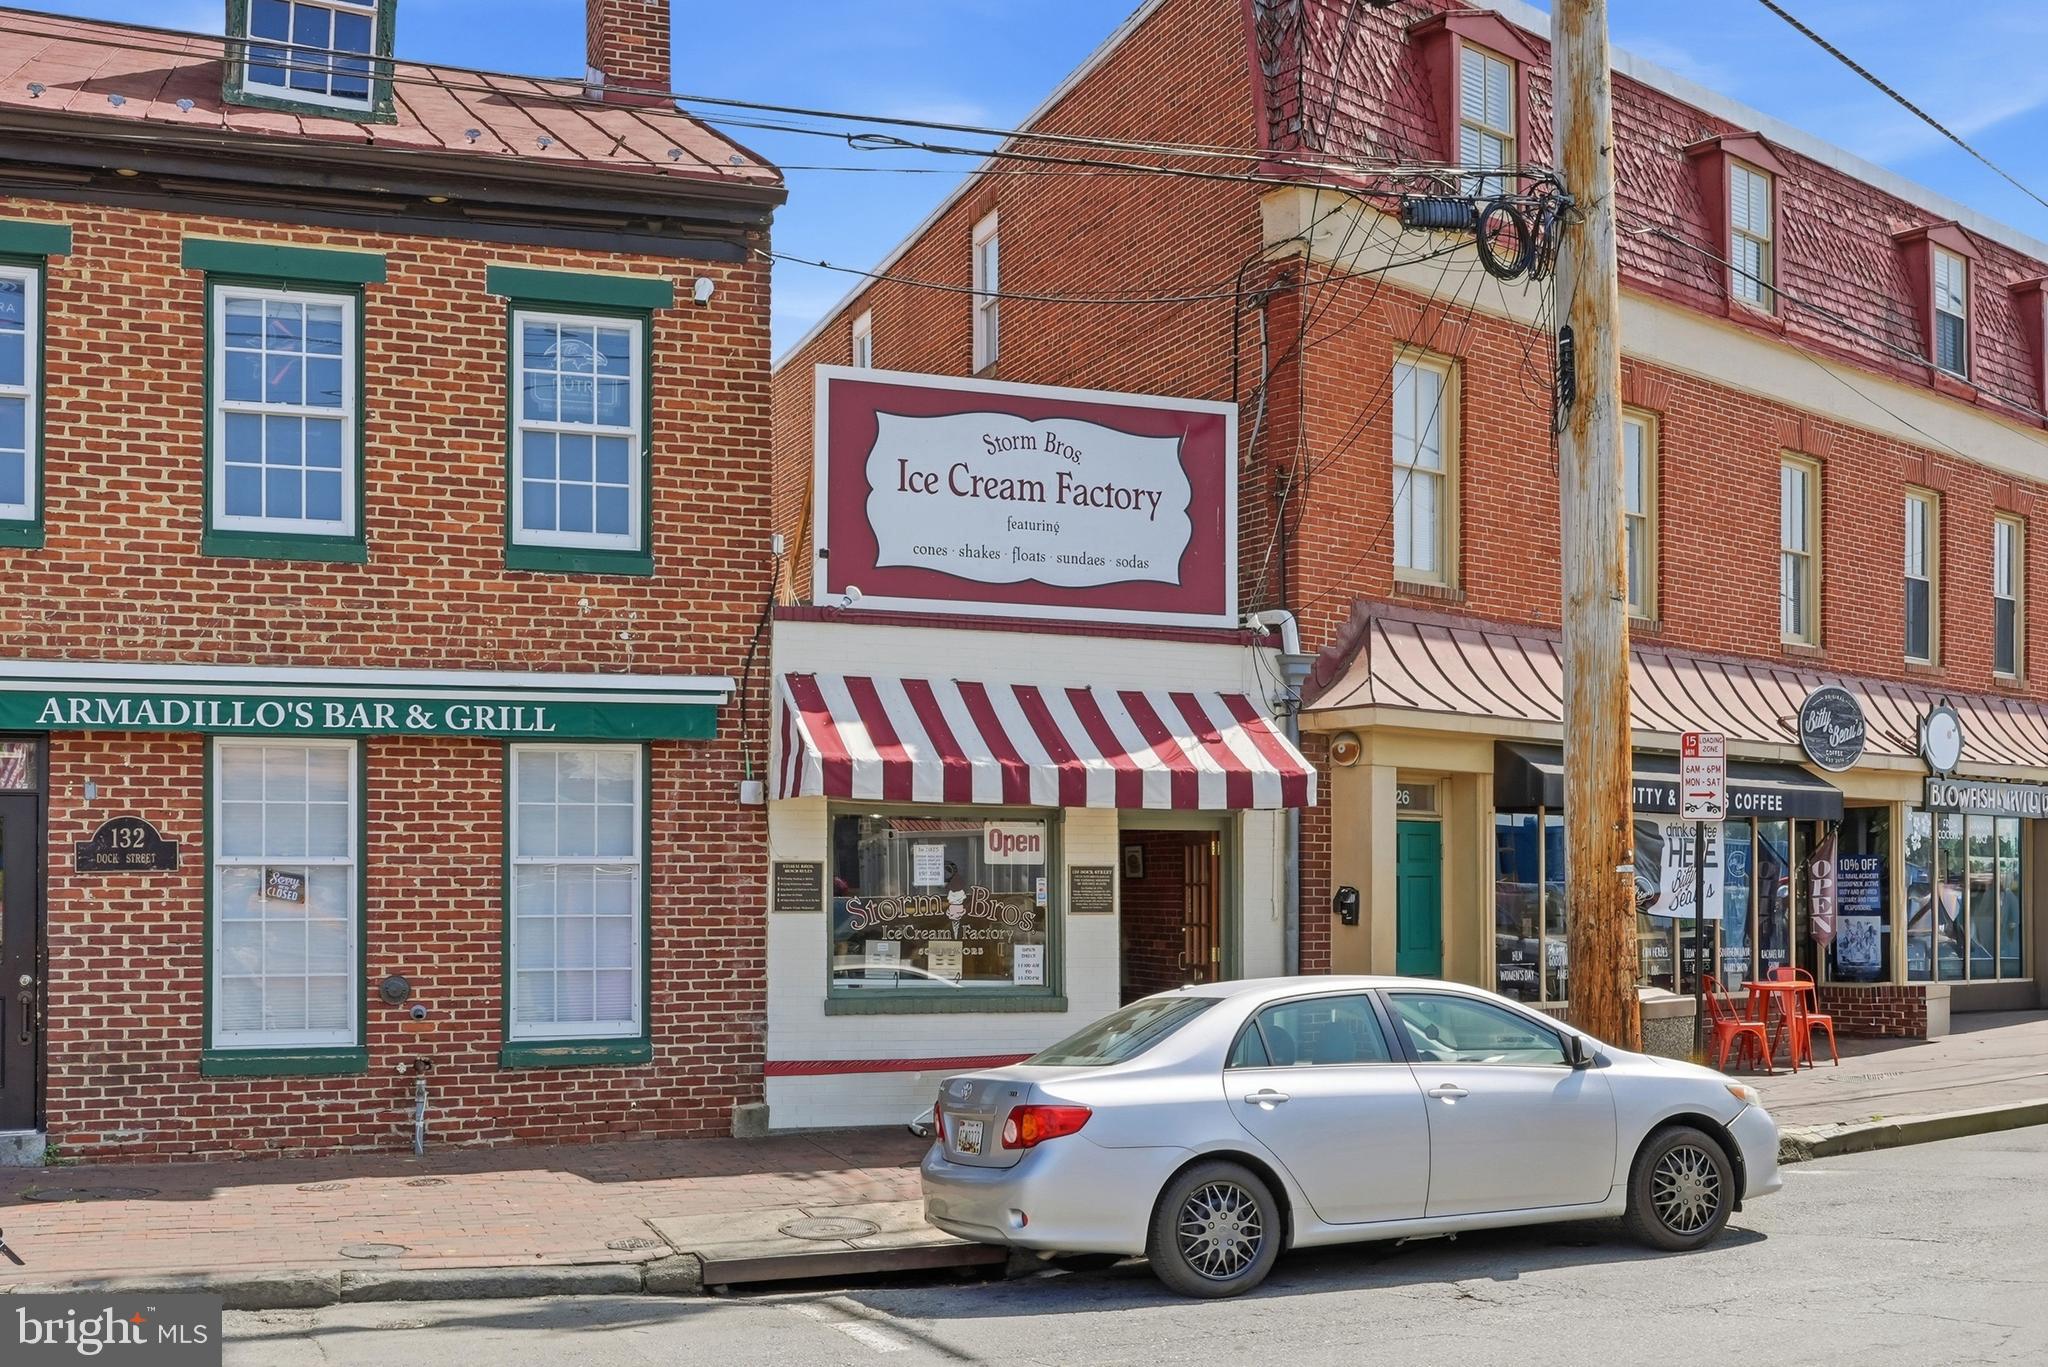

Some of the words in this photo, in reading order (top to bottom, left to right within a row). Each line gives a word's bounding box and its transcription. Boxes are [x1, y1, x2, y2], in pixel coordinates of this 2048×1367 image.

[982, 432, 1037, 456] Storm
[1044, 431, 1083, 465] Bros.
[897, 458, 939, 494] Ice
[948, 462, 1046, 504] Cream
[1056, 471, 1163, 521] Factory
[1007, 515, 1060, 536] featuring
[912, 543, 948, 557] cones
[958, 543, 1001, 560] shakes
[1011, 546, 1046, 564] floats
[1056, 551, 1106, 567] sundaes
[1115, 553, 1150, 569] sodas
[36, 697, 314, 729] ARMADILLO'S
[322, 702, 399, 729] BAR
[405, 705, 437, 730] &
[444, 704, 556, 732] GRILL
[1805, 707, 1831, 733] Bitty
[1685, 735, 1697, 747] 15
[1825, 749, 1844, 757] COFFEE
[1685, 765, 1700, 773] 6AM
[1706, 765, 1721, 773] 6PM
[1633, 787, 1662, 806] ITTY
[1668, 789, 1677, 806] &
[1735, 792, 1783, 811] COFFEE
[111, 828, 145, 849] 132
[1666, 823, 1688, 837] drink
[1690, 824, 1717, 838] cofee
[989, 828, 1040, 857] Open
[1669, 838, 1718, 868] HEE
[96, 853, 119, 864] DOCK
[126, 853, 156, 864] STREET
[1840, 858, 1859, 871] 10%
[1861, 858, 1878, 871] OFF
[266, 886, 298, 901] CLOSED
[1810, 859, 1833, 934] OPEN
[845, 894, 944, 931] Storm
[968, 885, 1037, 935] Bros.
[903, 924, 953, 940] Cream
[961, 925, 1014, 944] Factory
